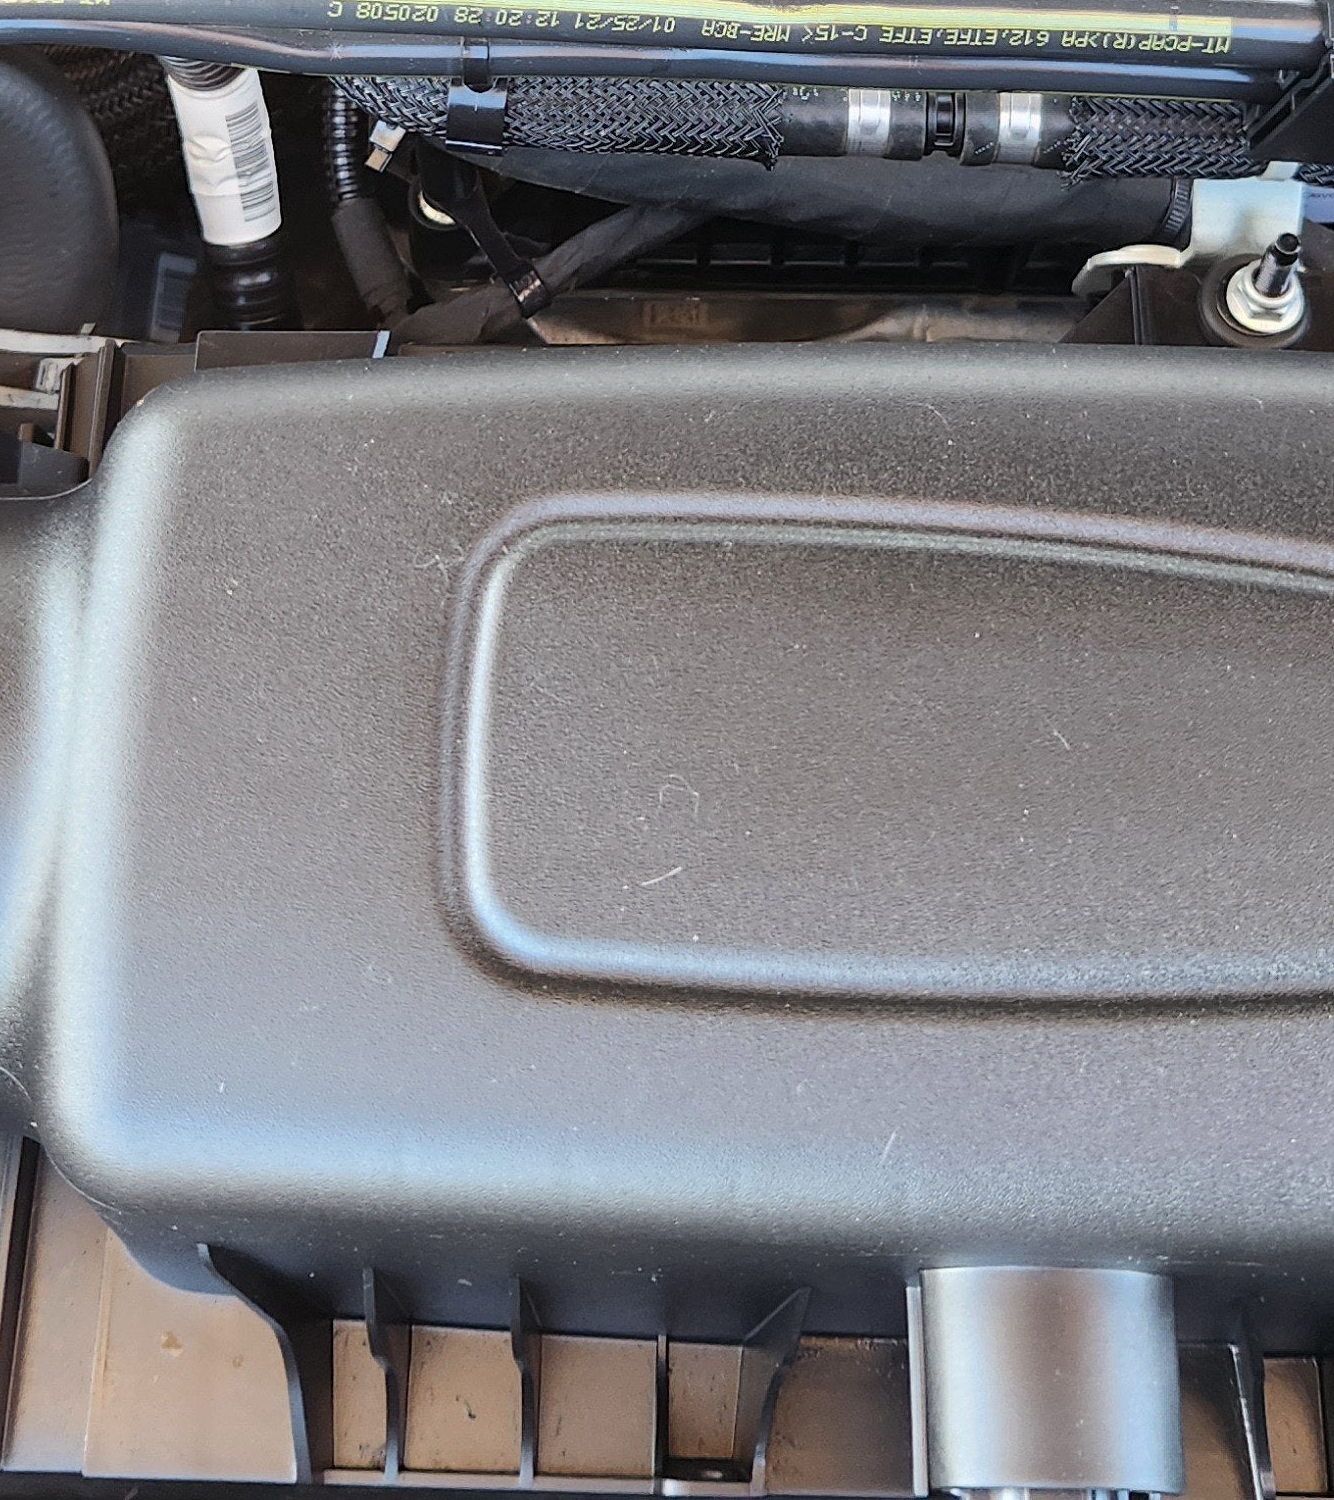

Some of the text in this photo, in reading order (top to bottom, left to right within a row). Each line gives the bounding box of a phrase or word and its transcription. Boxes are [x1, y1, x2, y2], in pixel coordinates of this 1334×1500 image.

[356, 2, 439, 23] 020508
[455, 6, 560, 29] 12:20:28
[574, 12, 676, 34] 01/25/21
